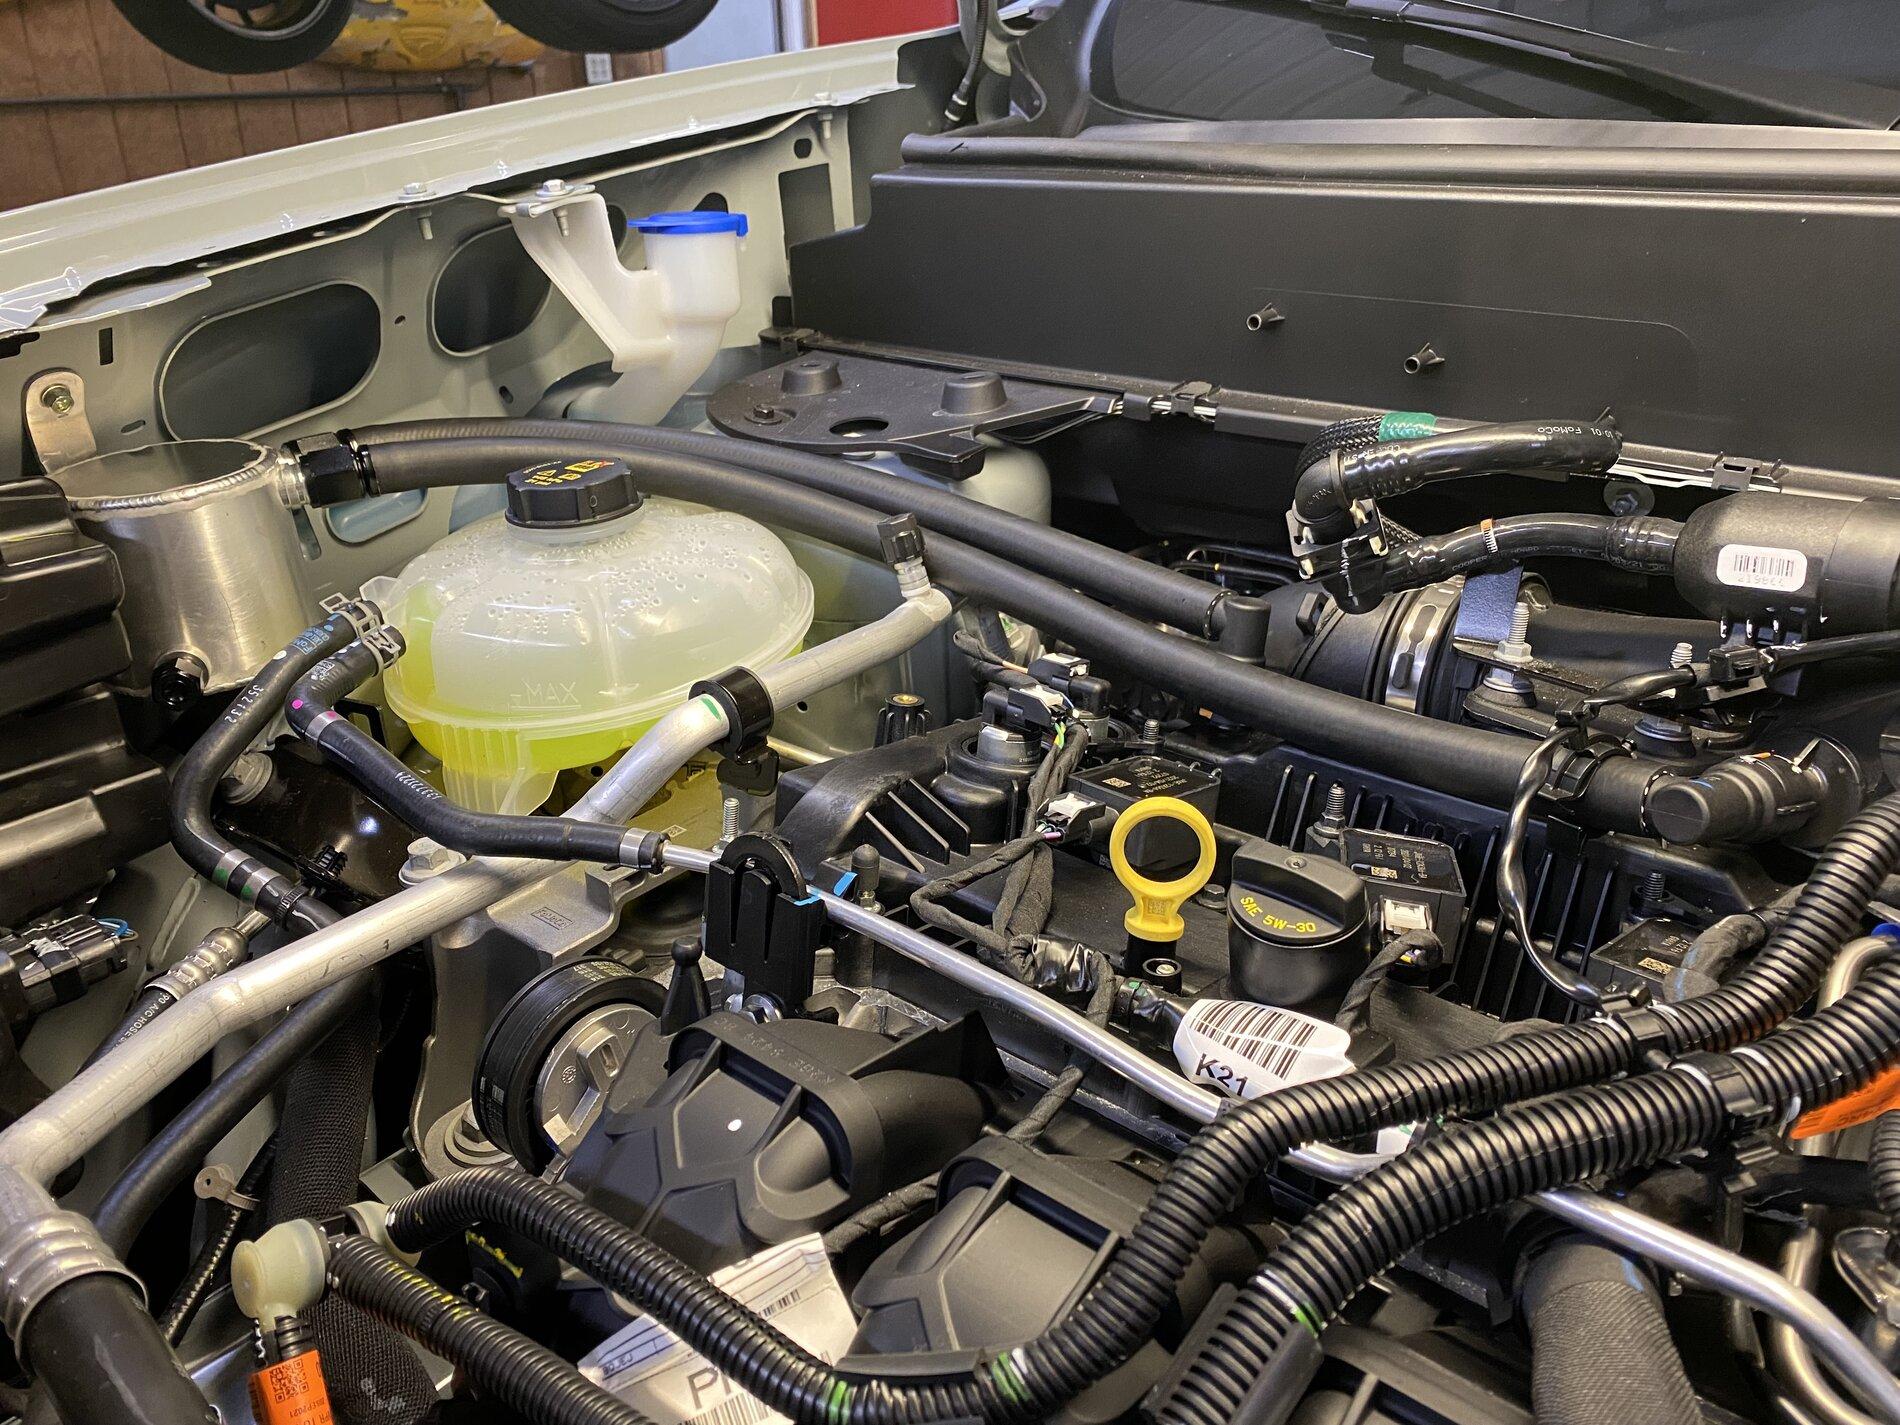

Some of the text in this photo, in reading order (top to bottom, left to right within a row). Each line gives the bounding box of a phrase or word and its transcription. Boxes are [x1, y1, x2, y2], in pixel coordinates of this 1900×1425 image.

[1537, 426, 1582, 435] FoMoCo
[521, 679, 579, 704] MAX
[1240, 896, 1316, 933] SAE 5W-30
[144, 1003, 159, 1017] A/C
[124, 1016, 148, 1037] HOSE
[1195, 1052, 1249, 1097] K21
